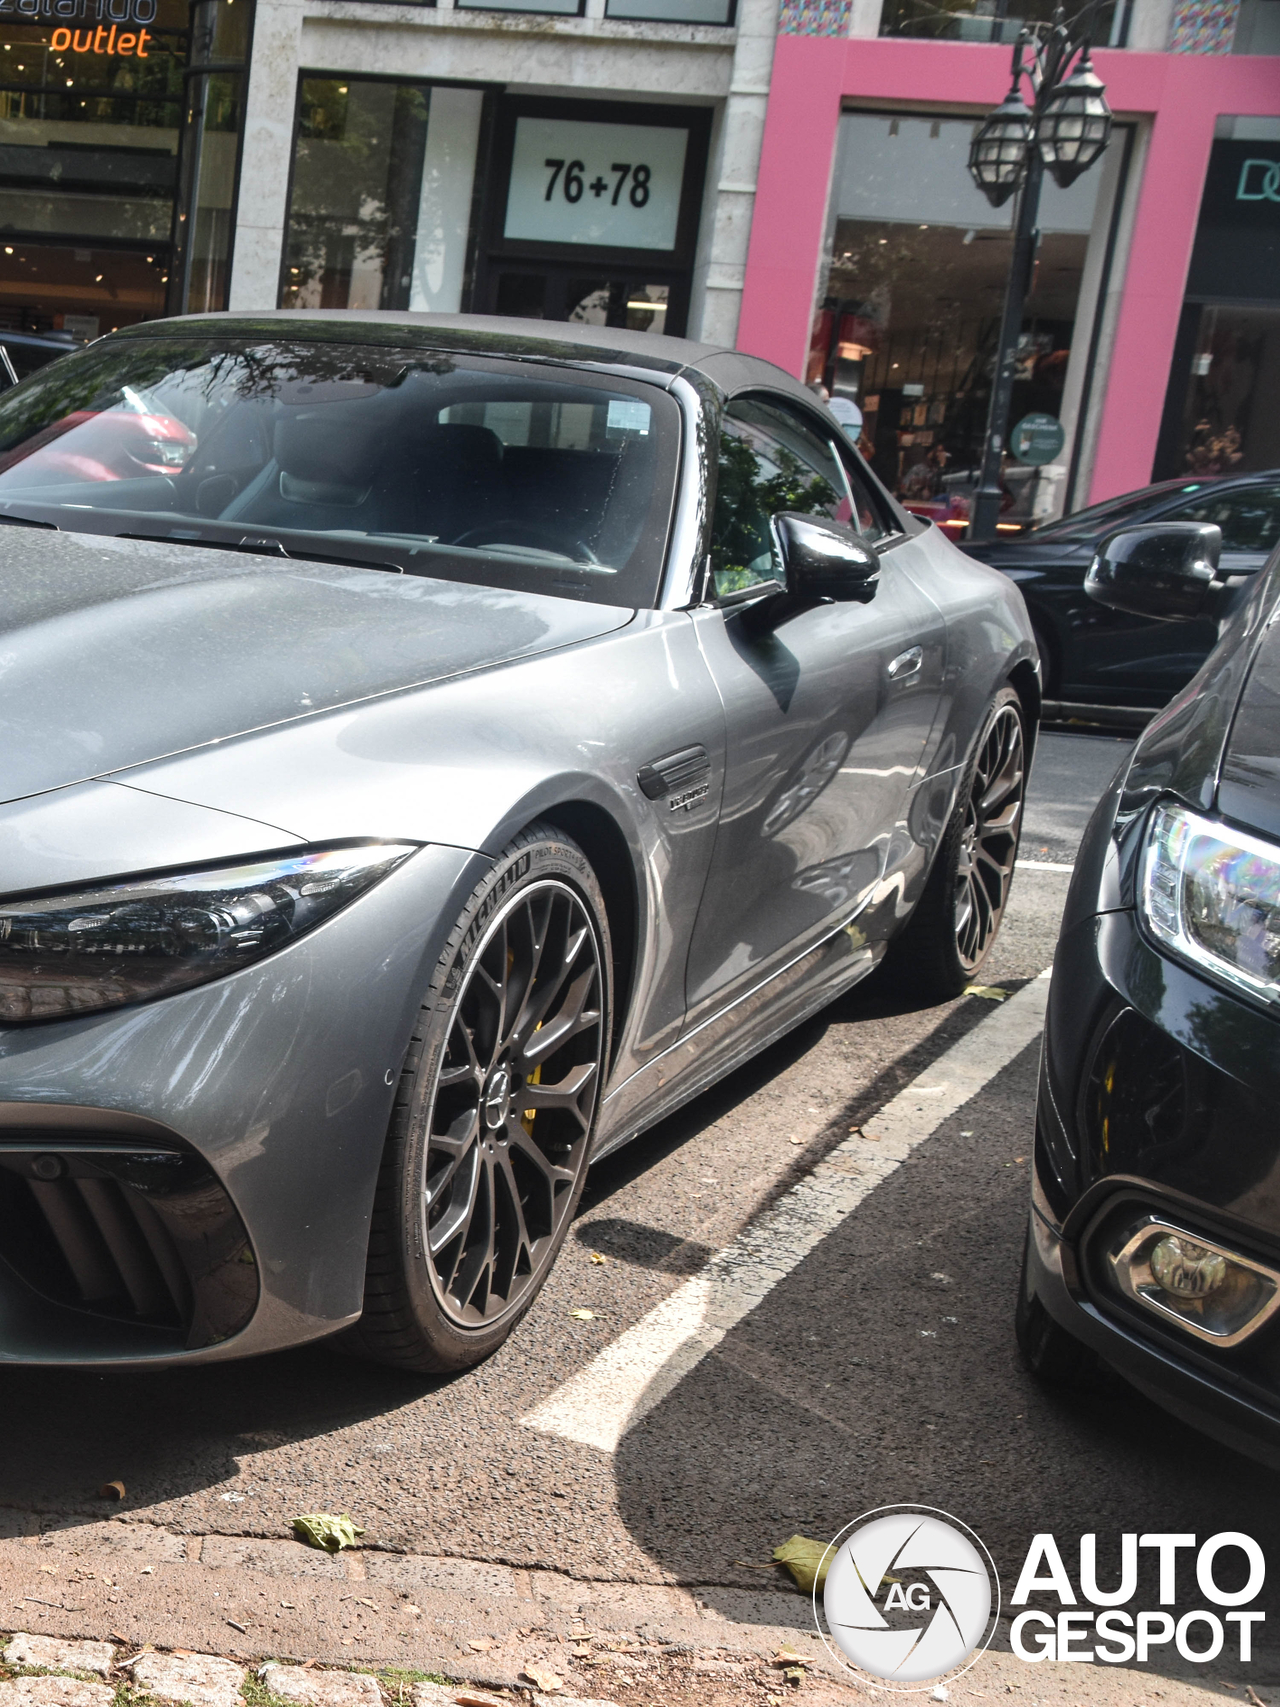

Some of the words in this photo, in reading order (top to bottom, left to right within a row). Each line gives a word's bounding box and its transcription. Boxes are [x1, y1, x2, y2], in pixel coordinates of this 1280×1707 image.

[51, 24, 151, 58] outlet
[545, 158, 651, 208] 76+78
[460, 855, 528, 963] MICHELIN
